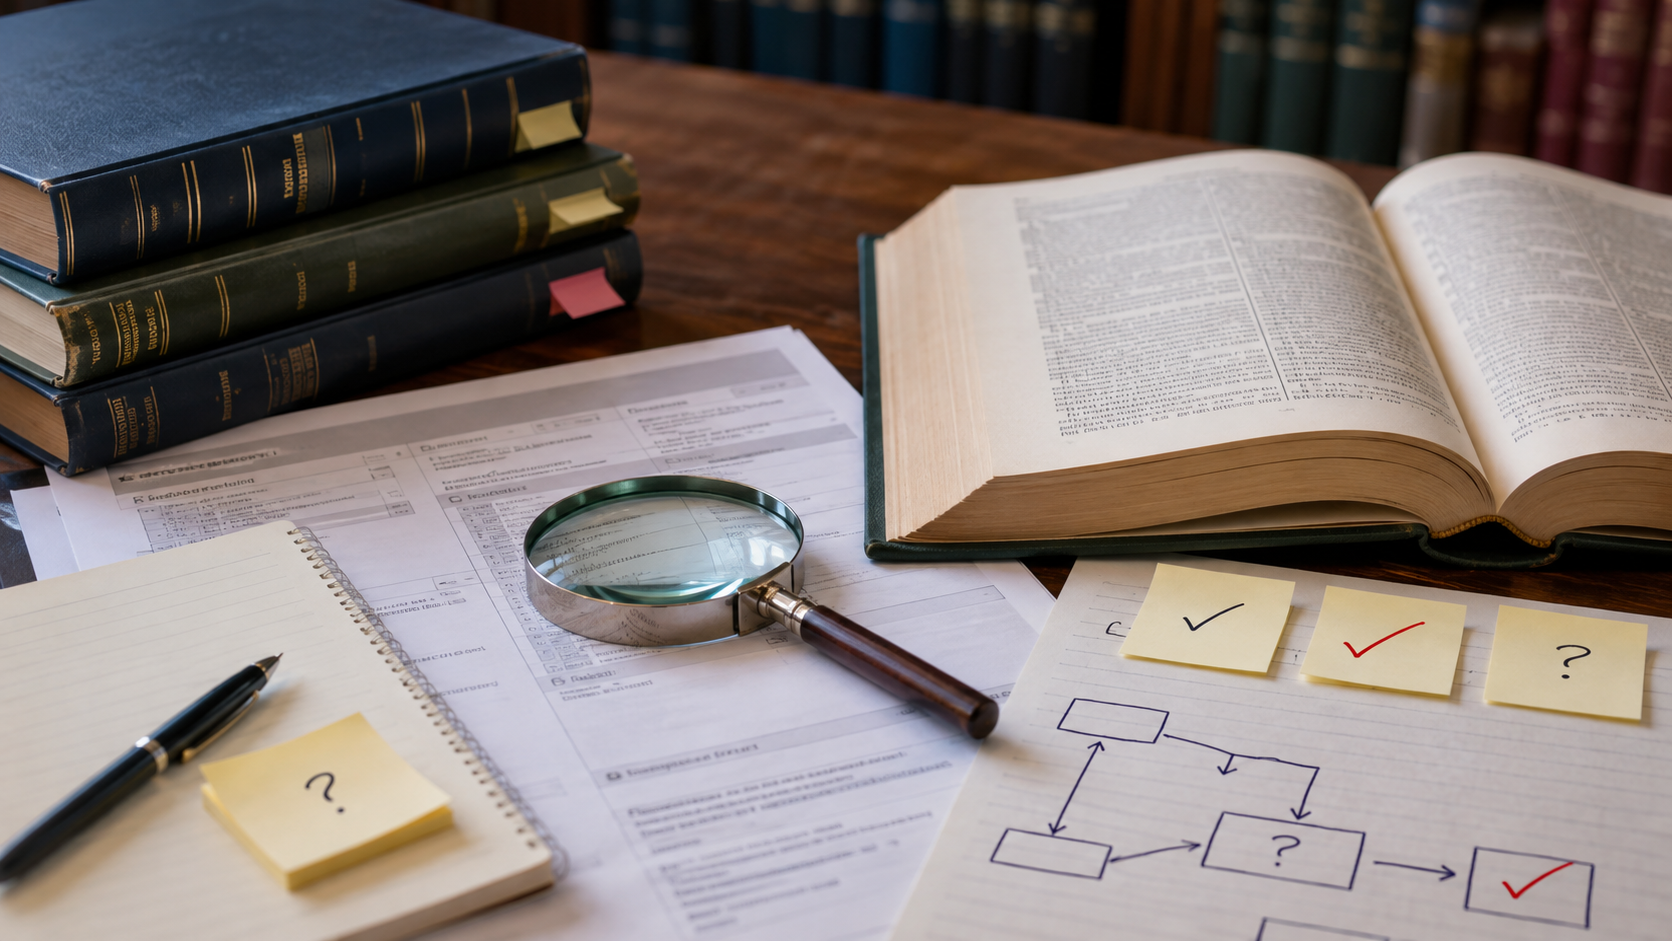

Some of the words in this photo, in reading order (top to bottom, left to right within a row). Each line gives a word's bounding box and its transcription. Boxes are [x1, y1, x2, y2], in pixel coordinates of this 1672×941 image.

[1556, 644, 1591, 679] ?
[305, 772, 344, 813] ?
[1272, 834, 1301, 867] ?
